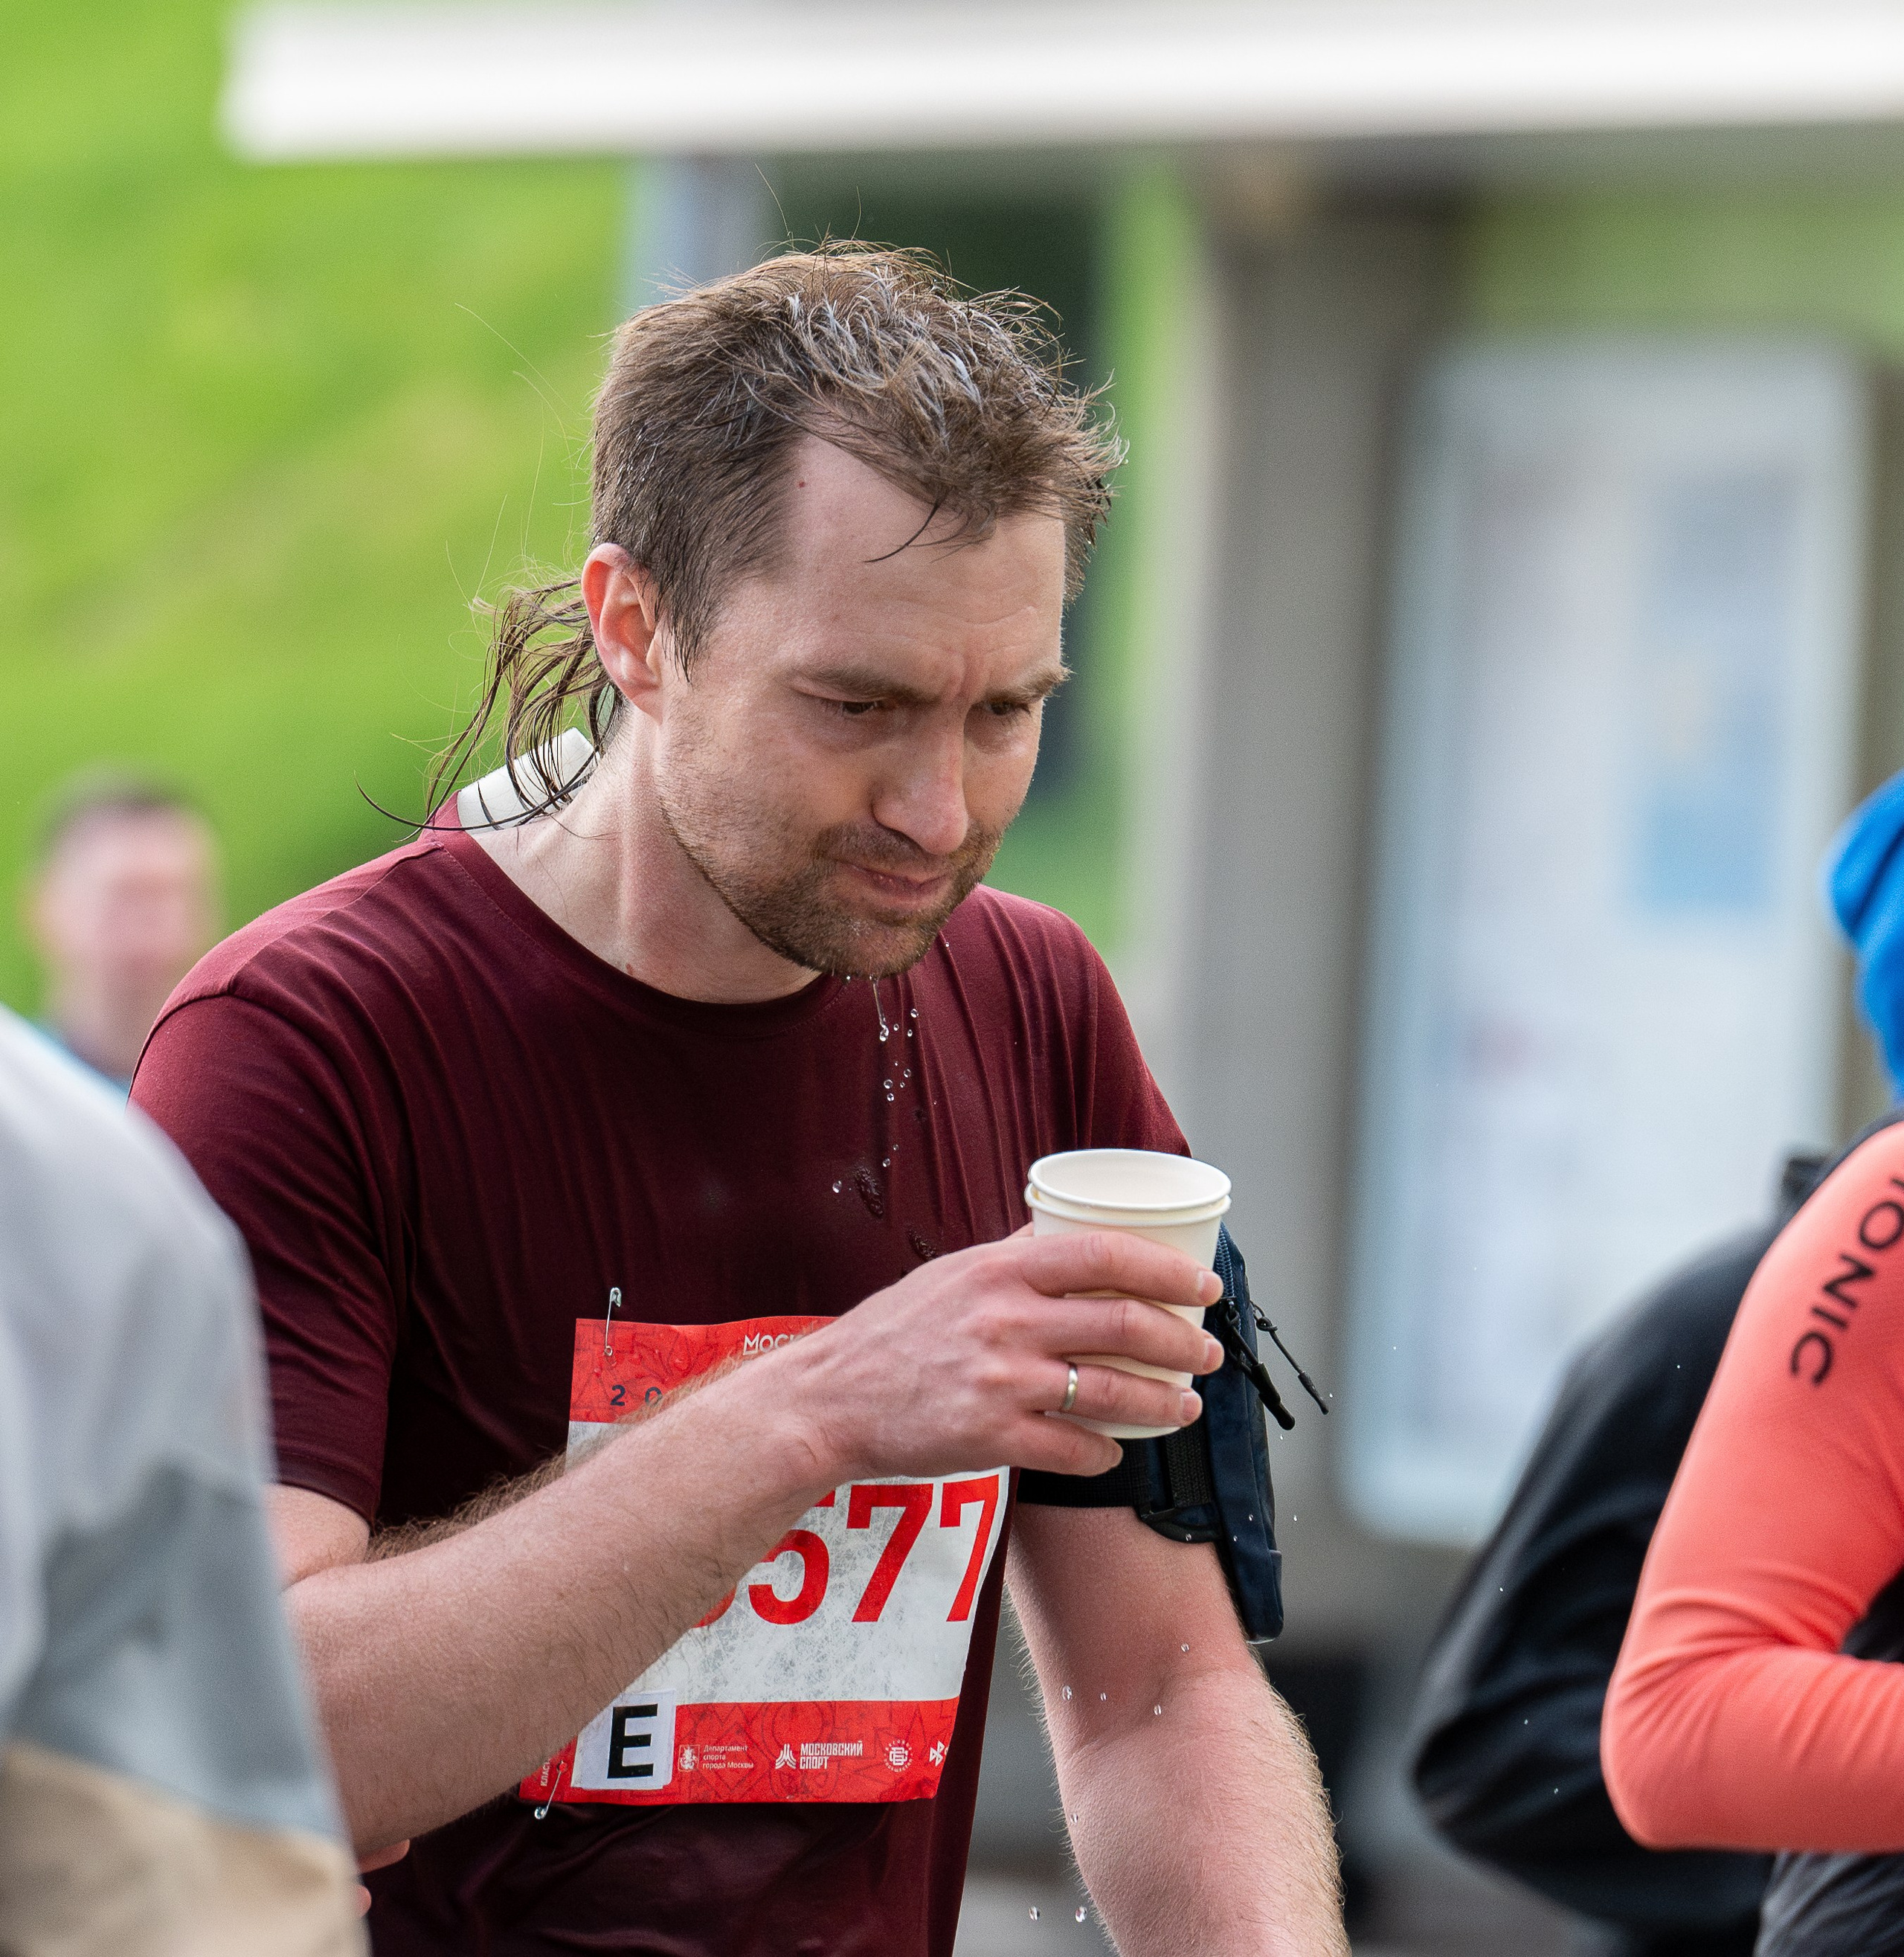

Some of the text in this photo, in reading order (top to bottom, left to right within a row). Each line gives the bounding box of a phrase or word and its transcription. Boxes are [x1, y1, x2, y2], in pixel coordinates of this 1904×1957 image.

[1789, 1176, 1904, 1389] ONIC
[743, 1332, 803, 1355] МОС
[689, 1474, 1000, 1628] 577
[607, 1703, 658, 1779] E
[800, 1740, 863, 1756] МОСКОВСКИЙ
[800, 1756, 829, 1770] СПОРТ
